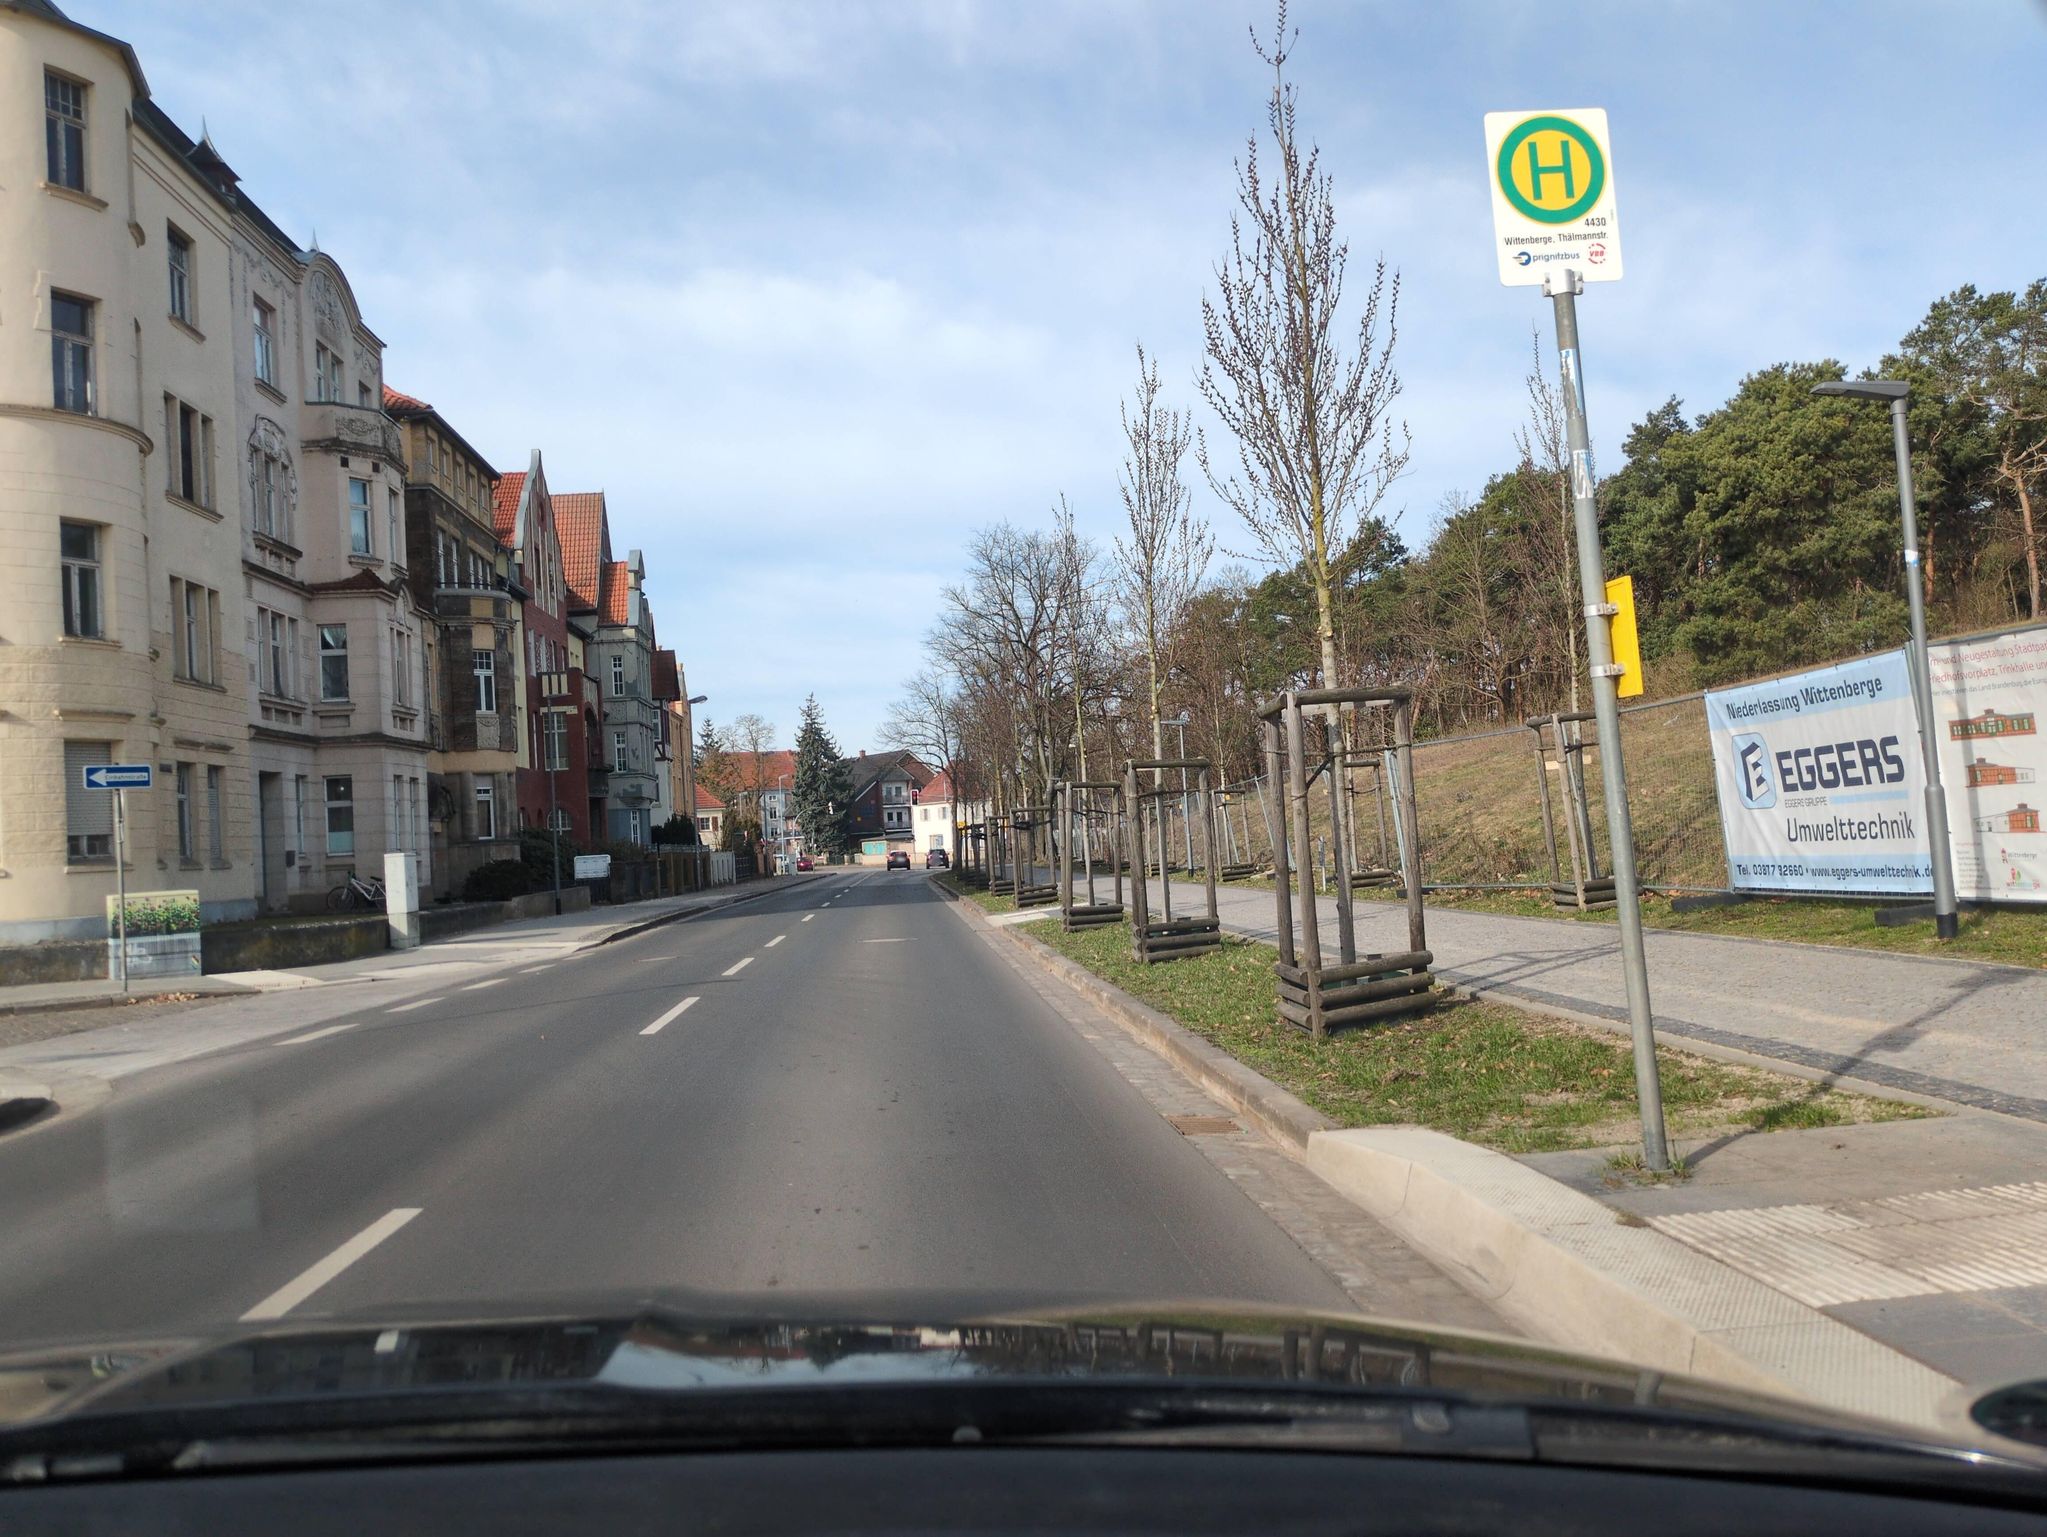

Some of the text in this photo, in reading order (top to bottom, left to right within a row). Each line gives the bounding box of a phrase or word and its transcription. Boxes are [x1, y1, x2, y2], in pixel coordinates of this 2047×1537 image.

[1528, 140, 1575, 200] H
[1584, 217, 1607, 227] 4430
[1558, 231, 1609, 242] Thälmannstr.
[1532, 252, 1580, 262] prignitzbus
[1998, 661, 2034, 674] Trinkhalle
[1726, 677, 1883, 720] Niederlassung Wittenberge
[1775, 735, 1905, 793] EGGERS
[1805, 796, 1828, 808] GRUPPE
[1787, 811, 1915, 843] Umwelttechnik
[1736, 864, 1751, 876] Tel.
[1777, 864, 1804, 877] 92660
